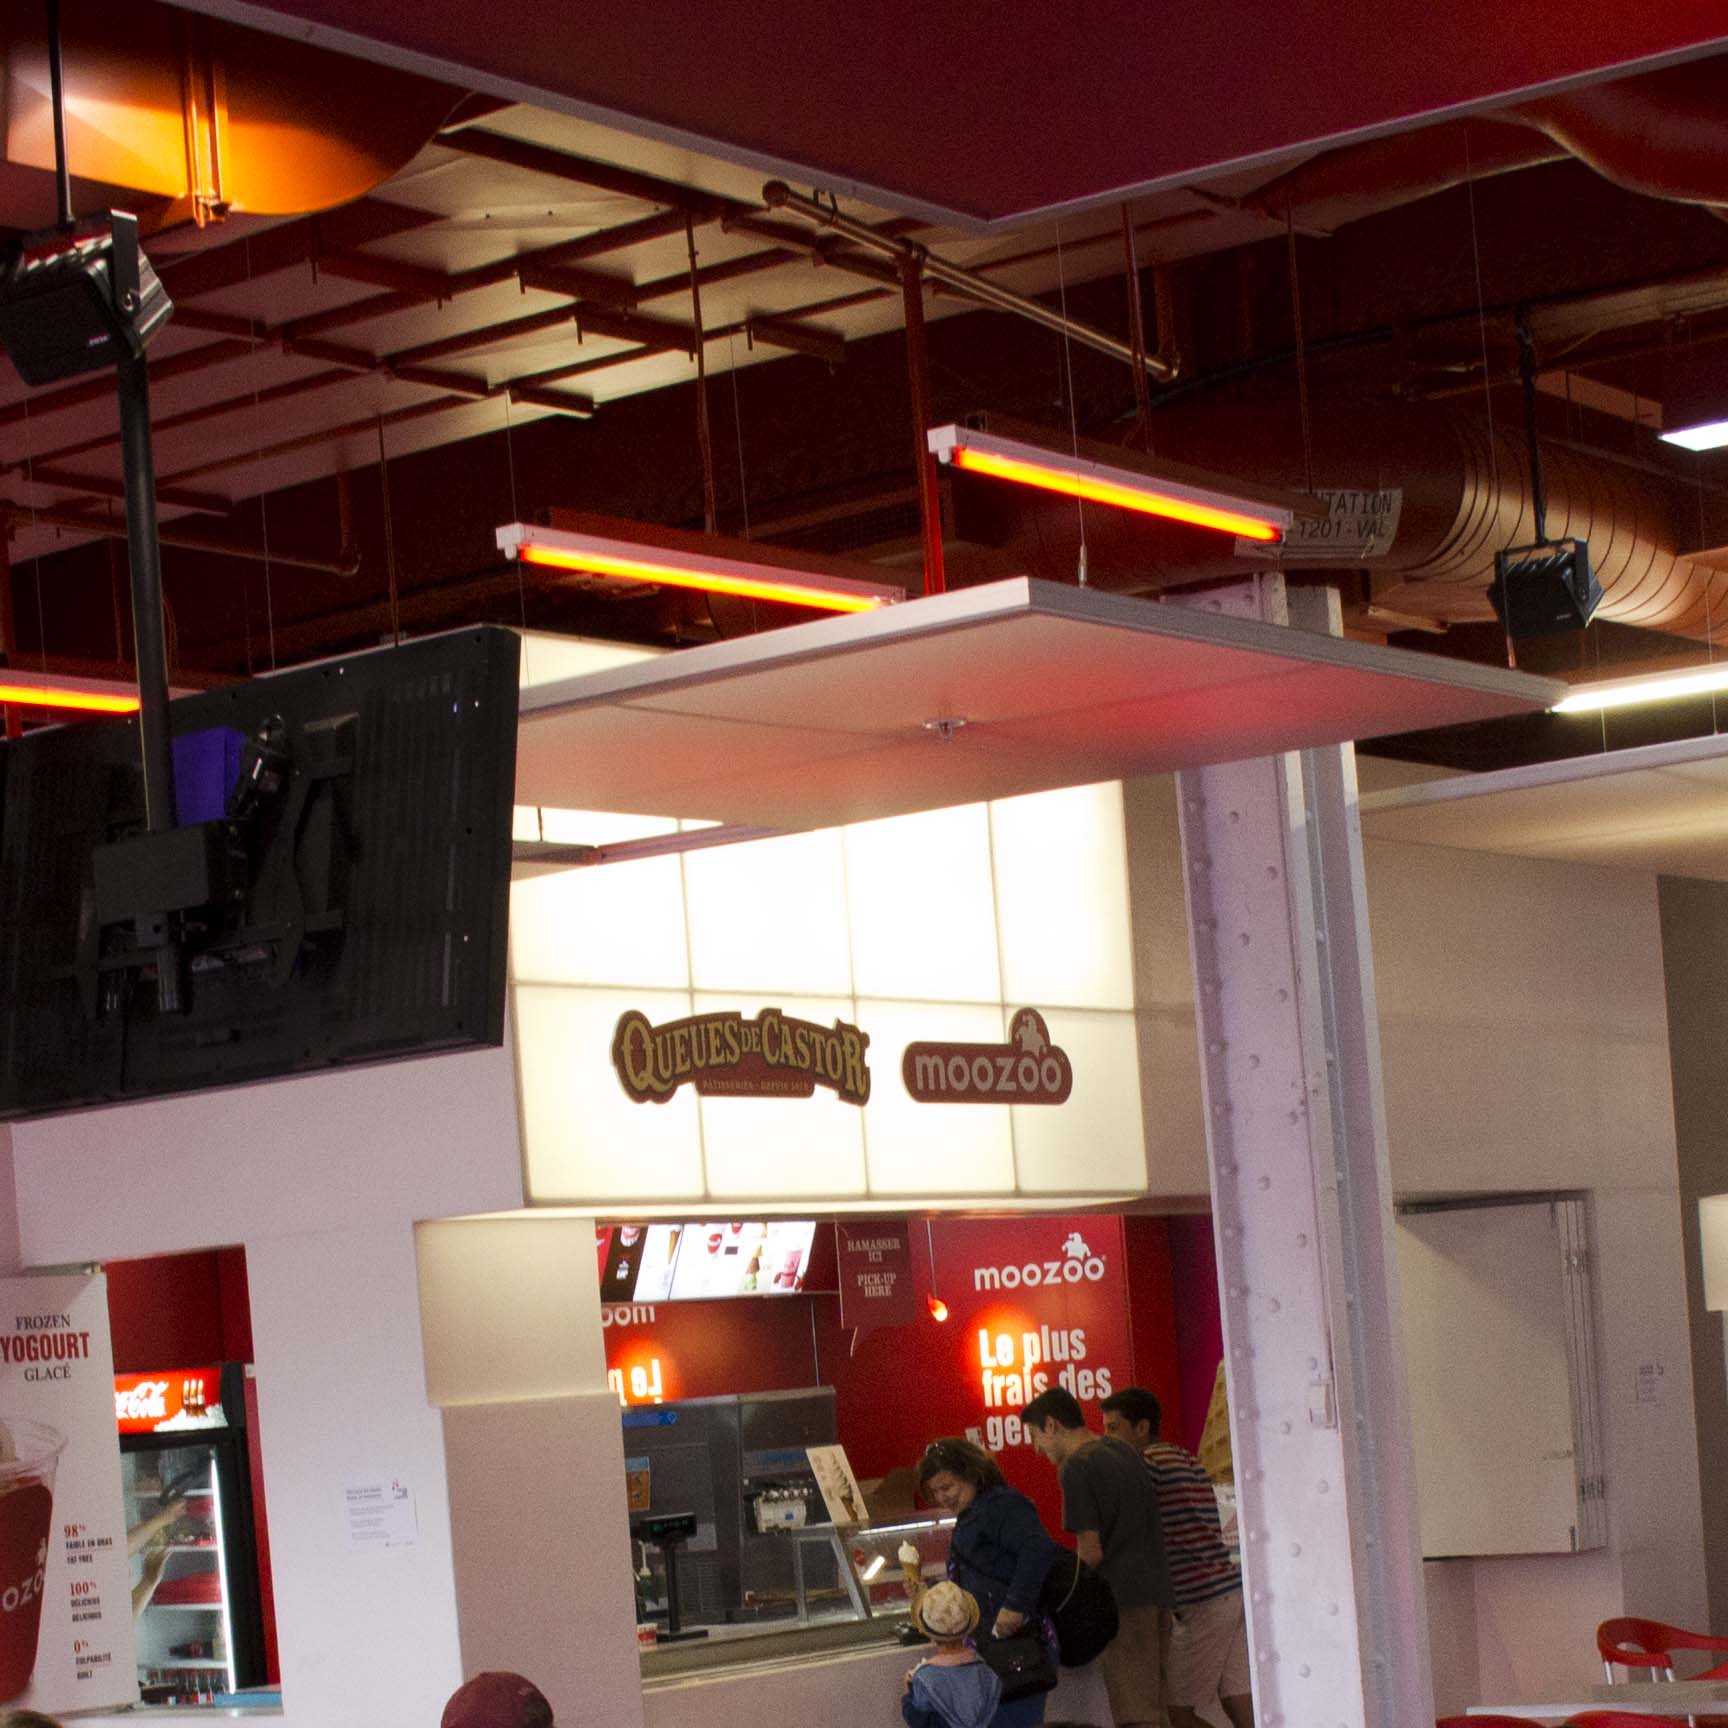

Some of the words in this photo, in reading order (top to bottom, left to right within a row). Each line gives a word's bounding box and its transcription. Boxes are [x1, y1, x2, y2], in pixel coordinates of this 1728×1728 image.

[622, 1018, 741, 1093] QUEUES
[741, 1026, 761, 1053] DE
[760, 1015, 868, 1098] CASTOR
[914, 1054, 1062, 1093] moozoo
[973, 1256, 1105, 1292] moozoo
[15, 1314, 72, 1332] FROZEN
[0, 1332, 90, 1364] YOGOURT
[978, 1328, 1015, 1369] Le
[1021, 1324, 1088, 1372] plus
[23, 1362, 72, 1383] GLACÉ
[981, 1368, 1049, 1408] frais
